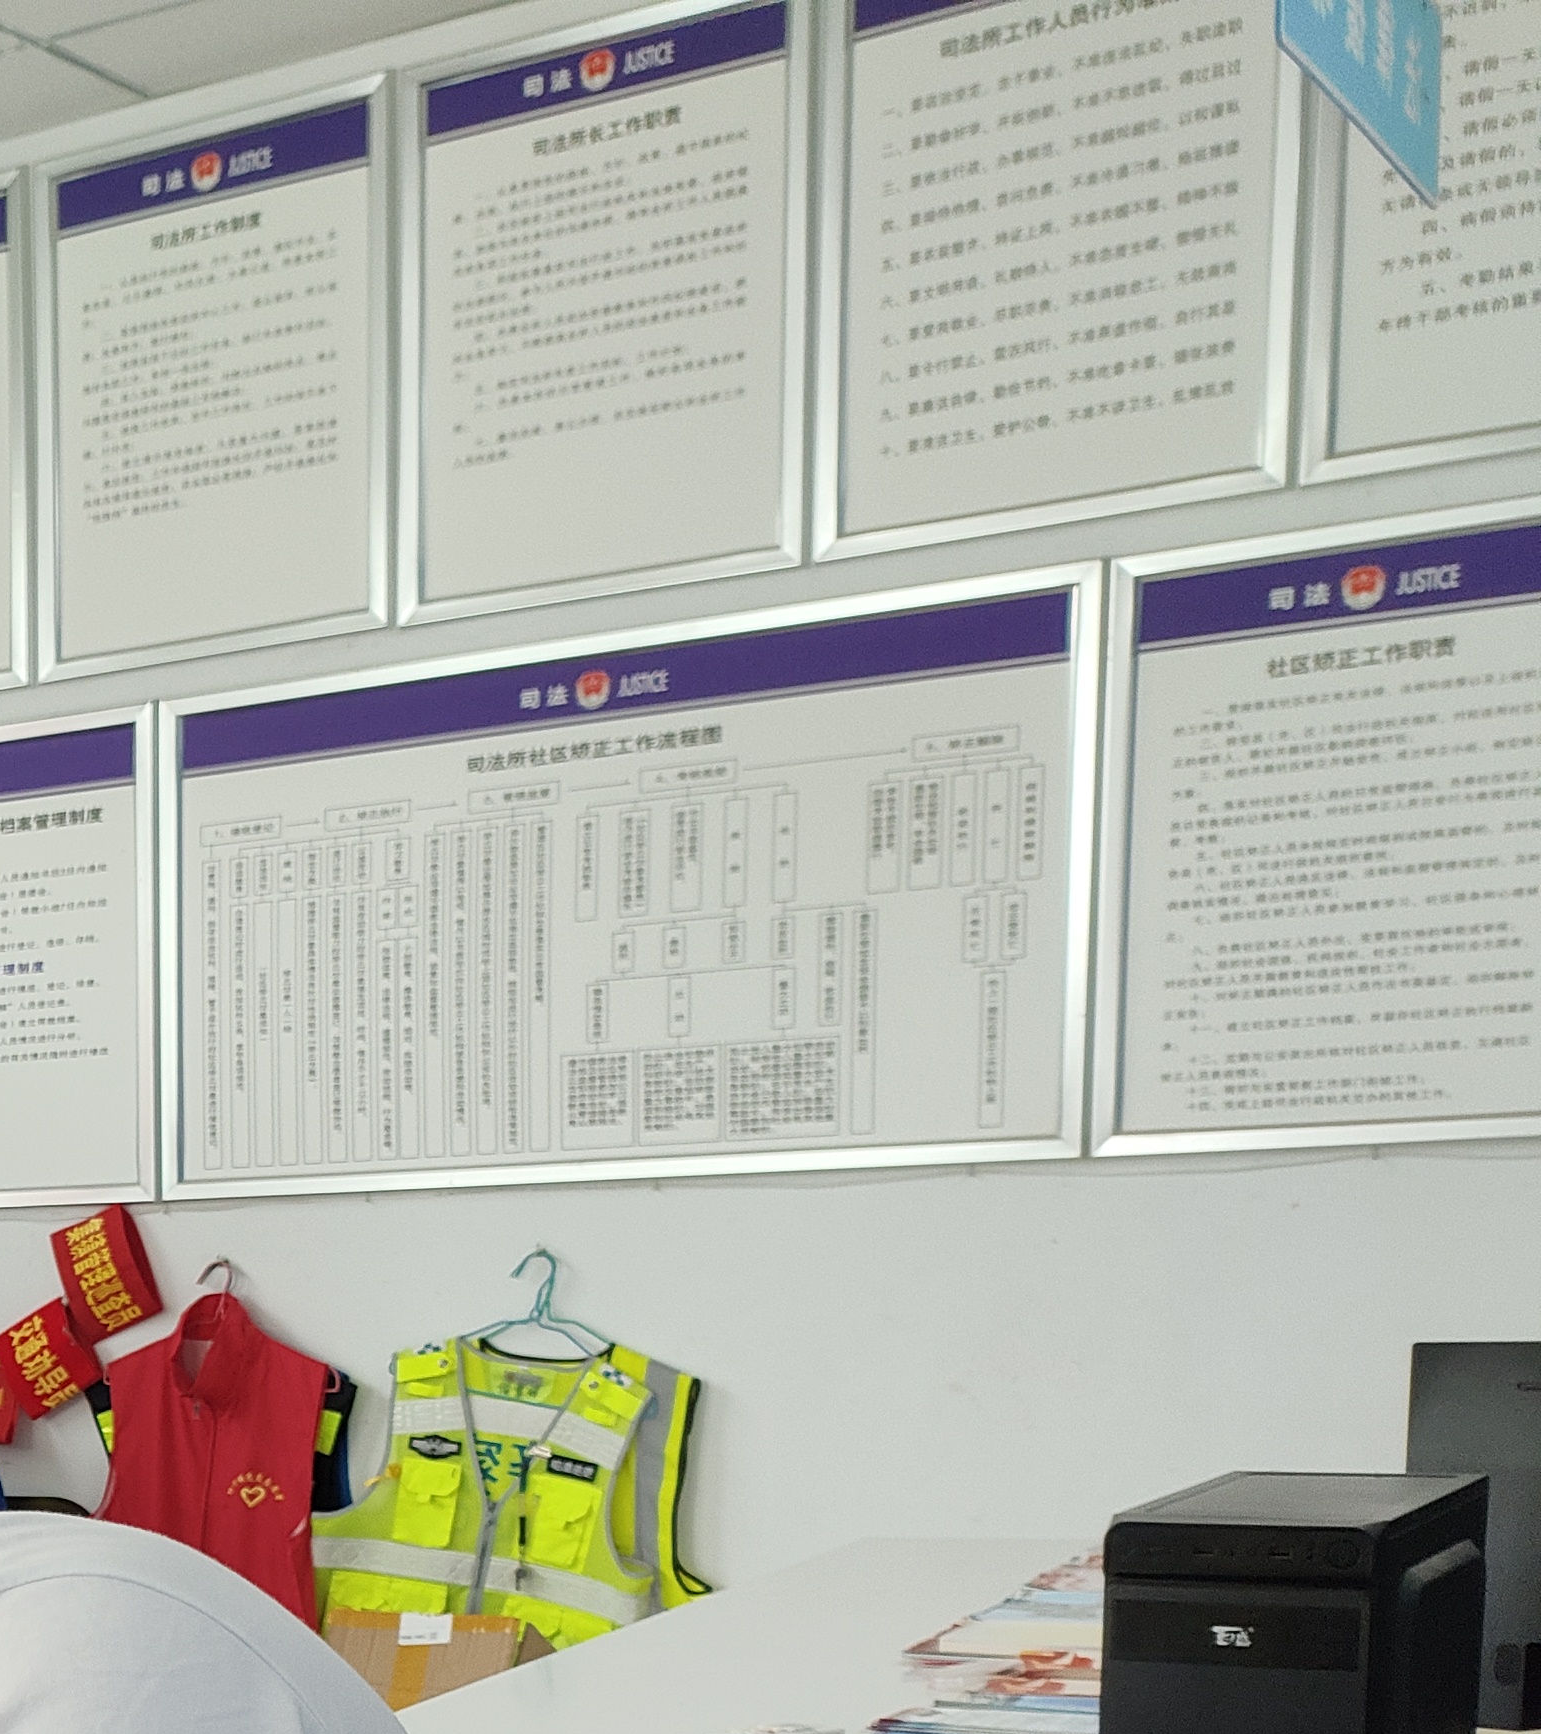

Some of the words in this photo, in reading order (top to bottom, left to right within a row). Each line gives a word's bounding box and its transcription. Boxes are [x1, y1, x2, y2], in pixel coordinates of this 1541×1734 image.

[523, 68, 573, 98] 司法
[623, 40, 675, 75] JUSTICE
[1268, 581, 1332, 612] 司法
[1395, 563, 1463, 597] JUSTICE
[1266, 636, 1458, 681] 社区矫正工作职责
[519, 683, 570, 710] 司法
[617, 668, 670, 698] JUSTICE
[465, 724, 724, 774] 司法所社区矫正工作流程图
[8, 1314, 81, 1409] 交通劝导员
